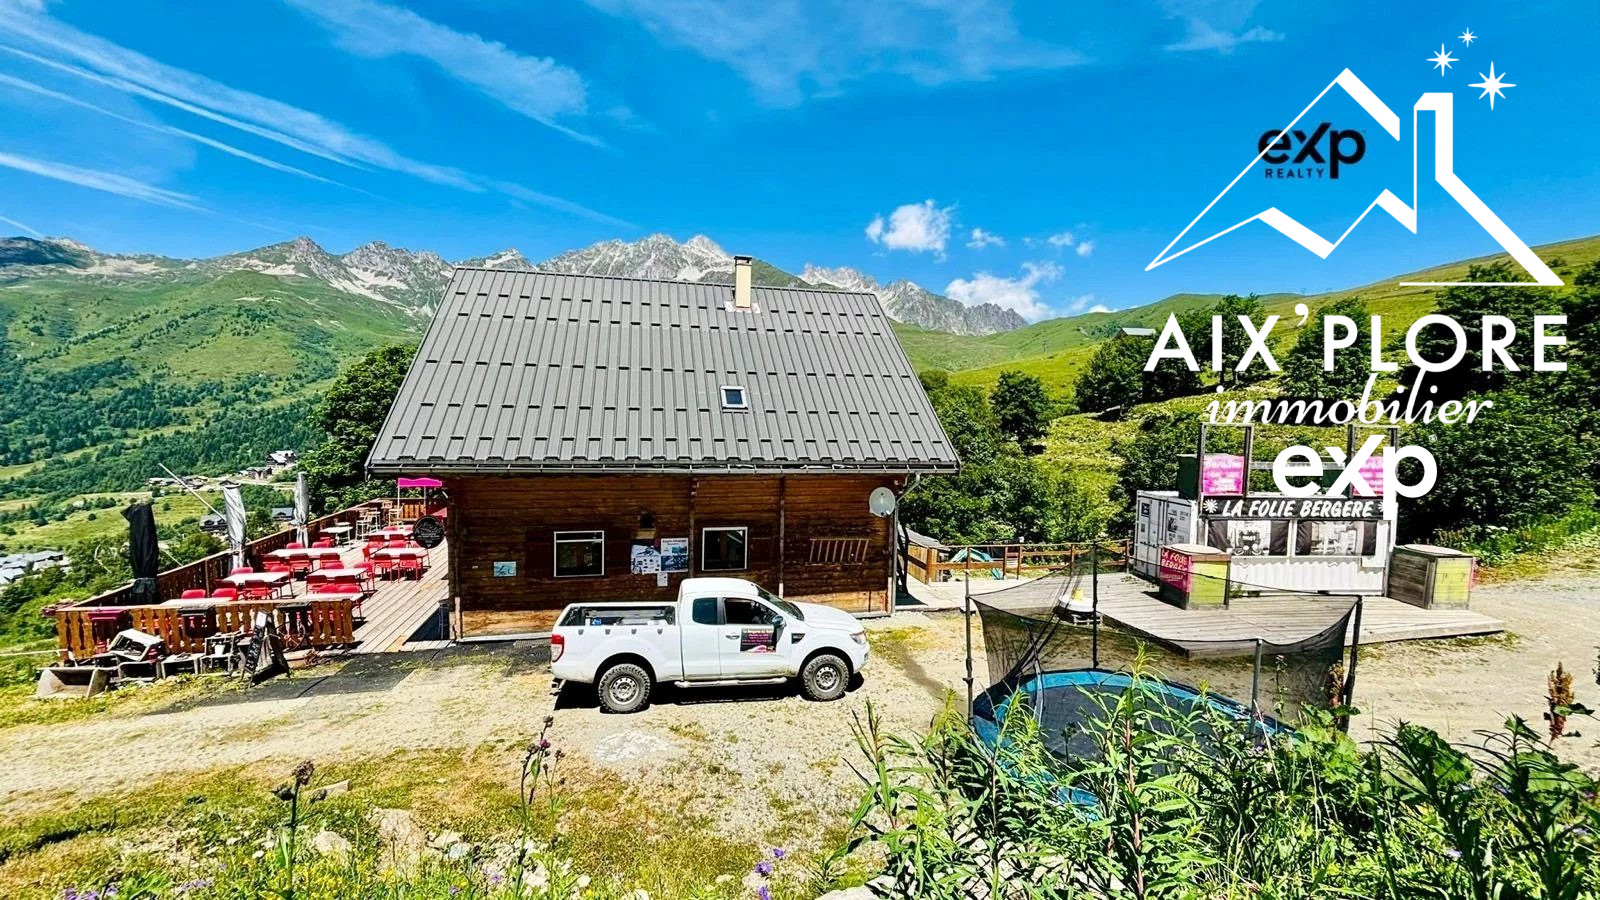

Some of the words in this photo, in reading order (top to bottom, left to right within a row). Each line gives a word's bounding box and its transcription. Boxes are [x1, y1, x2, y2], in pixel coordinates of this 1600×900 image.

[1222, 500, 1244, 518] LA
[1249, 500, 1296, 518] FOLIE
[1300, 500, 1373, 518] BERGERE
